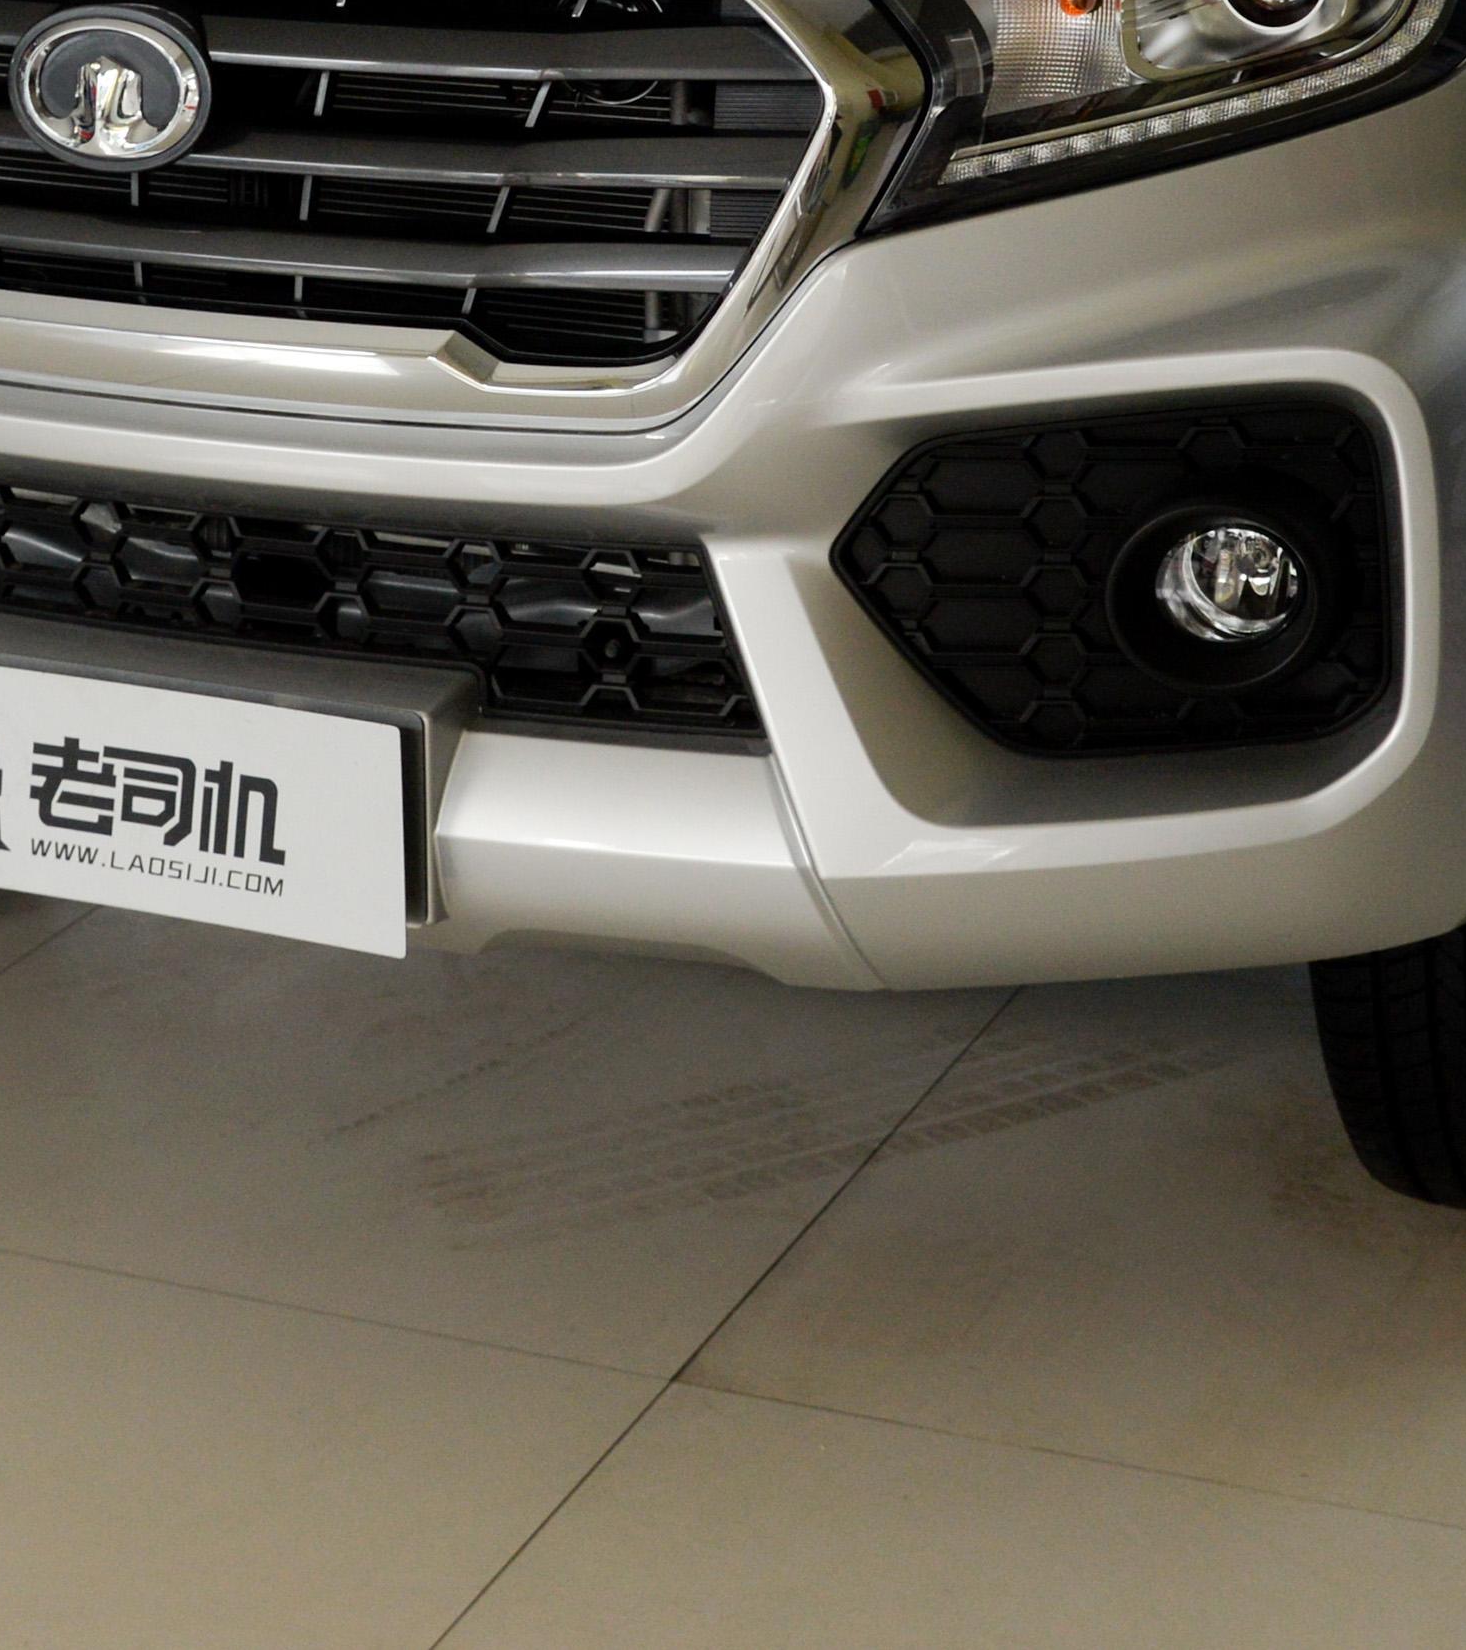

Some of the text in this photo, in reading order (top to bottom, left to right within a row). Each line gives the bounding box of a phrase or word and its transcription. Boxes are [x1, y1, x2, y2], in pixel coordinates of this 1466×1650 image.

[30, 736, 286, 866] 老司机
[30, 838, 284, 897] WWW.LAOSIJI.COM
